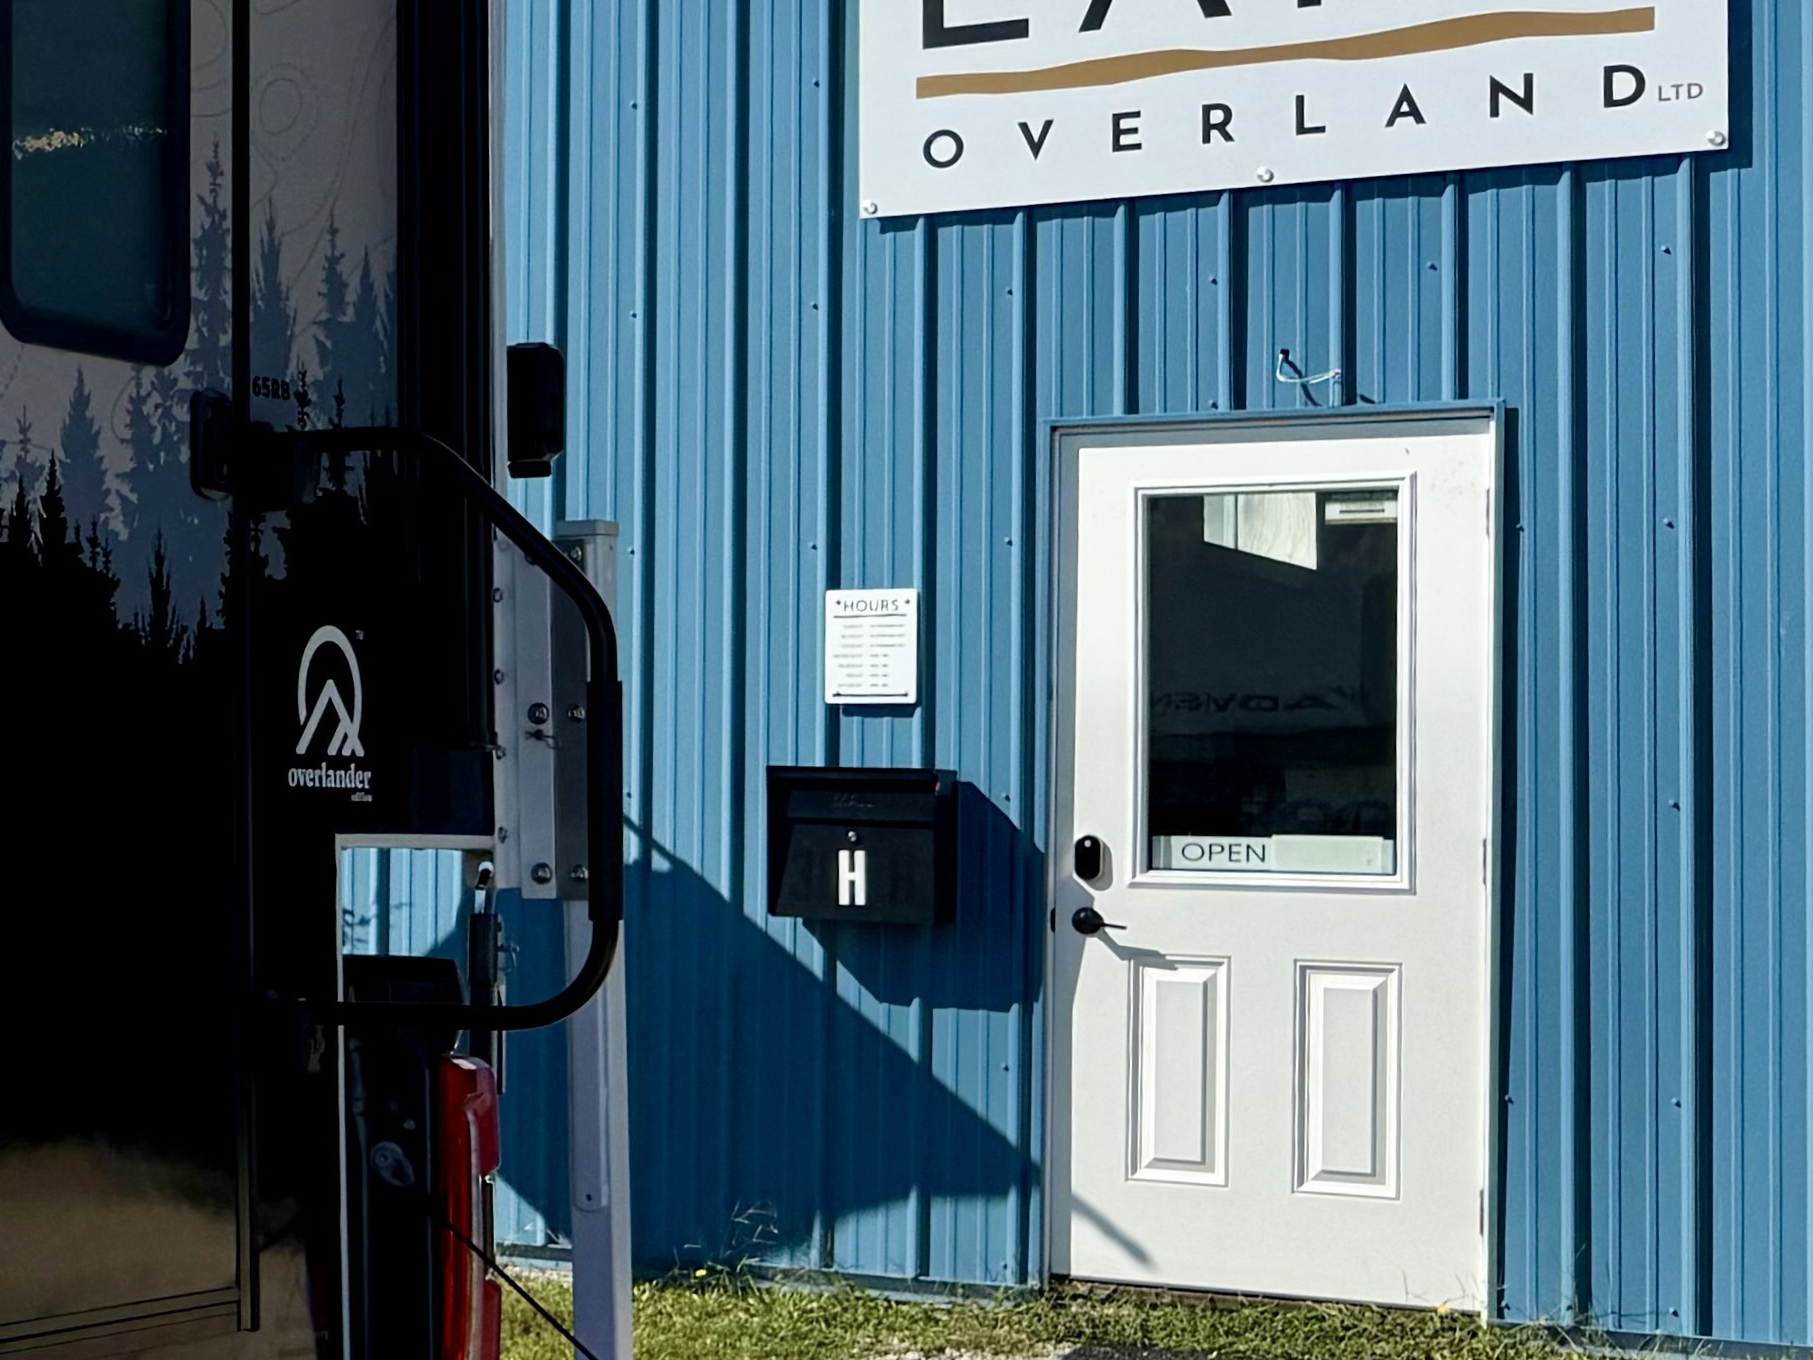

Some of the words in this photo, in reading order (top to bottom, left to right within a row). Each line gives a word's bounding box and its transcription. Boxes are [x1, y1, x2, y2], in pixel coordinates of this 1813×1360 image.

[923, 63, 1647, 169] OVERLAND
[1657, 81, 1704, 104] LTD
[252, 375, 291, 401] 65RB
[843, 599, 900, 613] HOURS
[288, 761, 372, 789] overlander
[1180, 842, 1267, 863] OPEN
[838, 849, 866, 907] H
